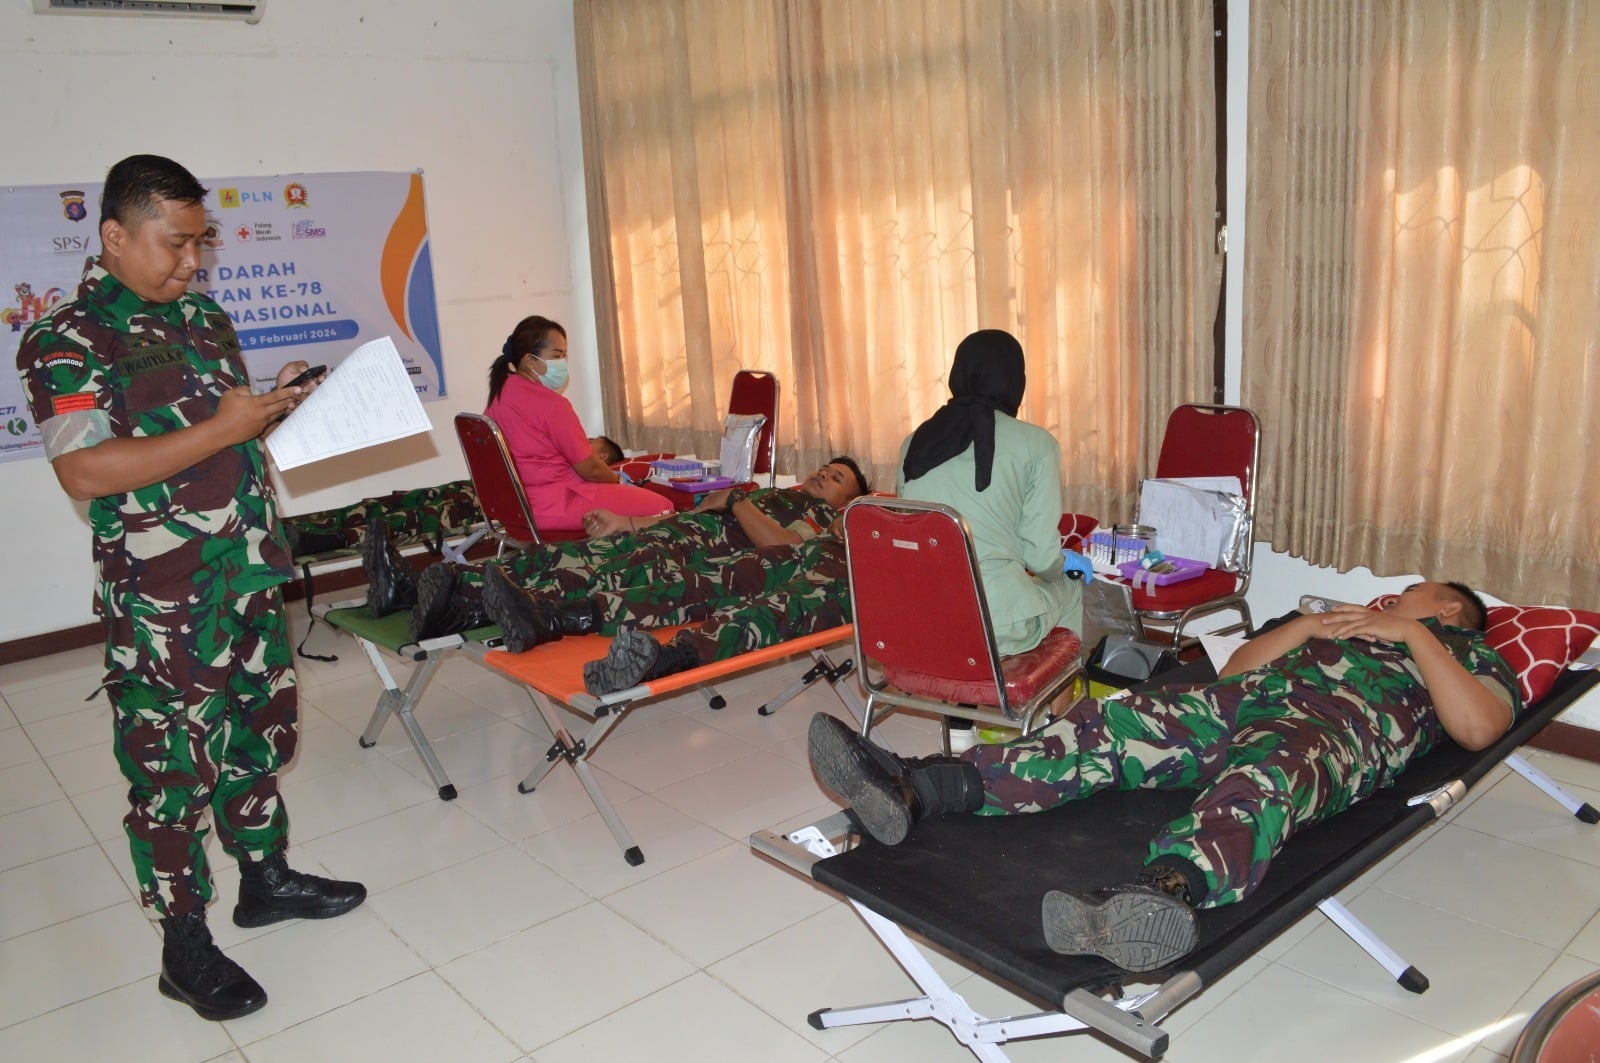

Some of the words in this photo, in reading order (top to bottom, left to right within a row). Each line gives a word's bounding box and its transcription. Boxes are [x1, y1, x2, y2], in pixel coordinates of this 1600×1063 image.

[241, 191, 273, 203] PLN
[304, 227, 326, 237] SMSI
[53, 236, 82, 251] SPS
[218, 261, 296, 281] DARAH
[261, 281, 322, 300] KE-78
[228, 301, 337, 324] NASIONAL
[250, 336, 257, 345] 9
[260, 331, 308, 344] Februari
[310, 328, 337, 338] 2024
